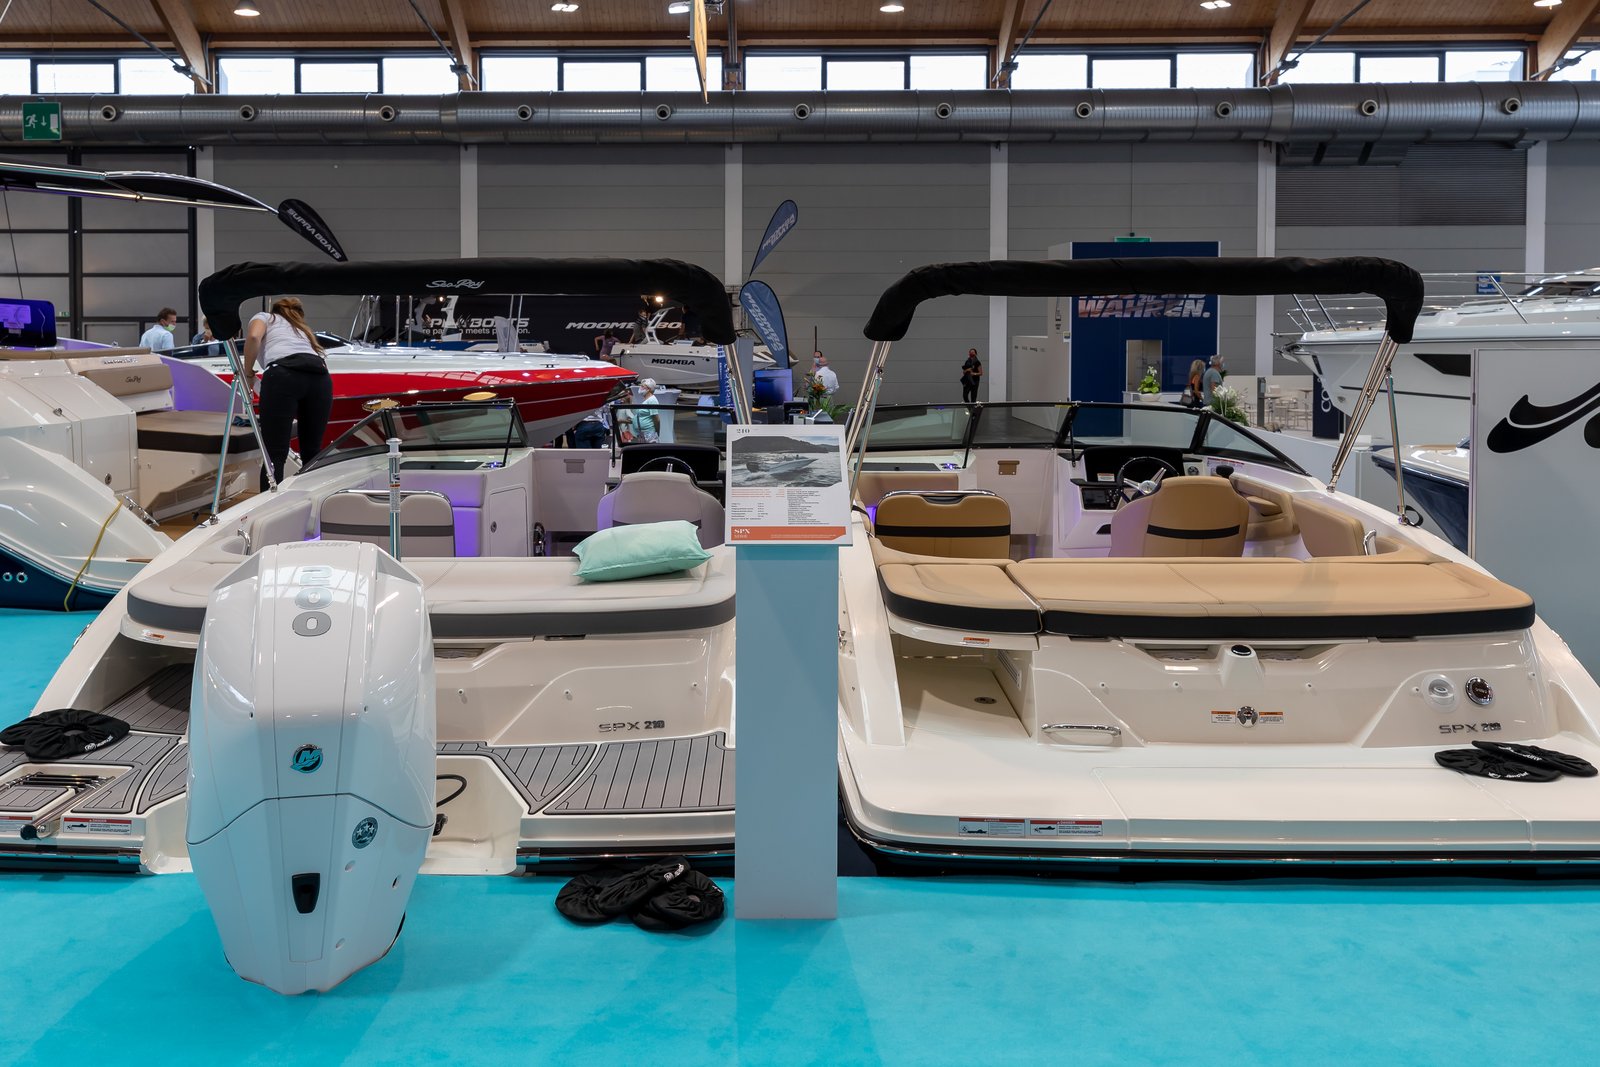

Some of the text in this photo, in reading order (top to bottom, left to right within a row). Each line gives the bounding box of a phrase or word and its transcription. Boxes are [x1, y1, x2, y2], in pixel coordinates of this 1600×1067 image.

[287, 208, 342, 259] SUPRA BOATS
[1078, 299, 1211, 318] WAHREN.
[651, 358, 695, 366] MOOMBA
[599, 721, 640, 733] SPX
[1439, 723, 1478, 734] SPX
